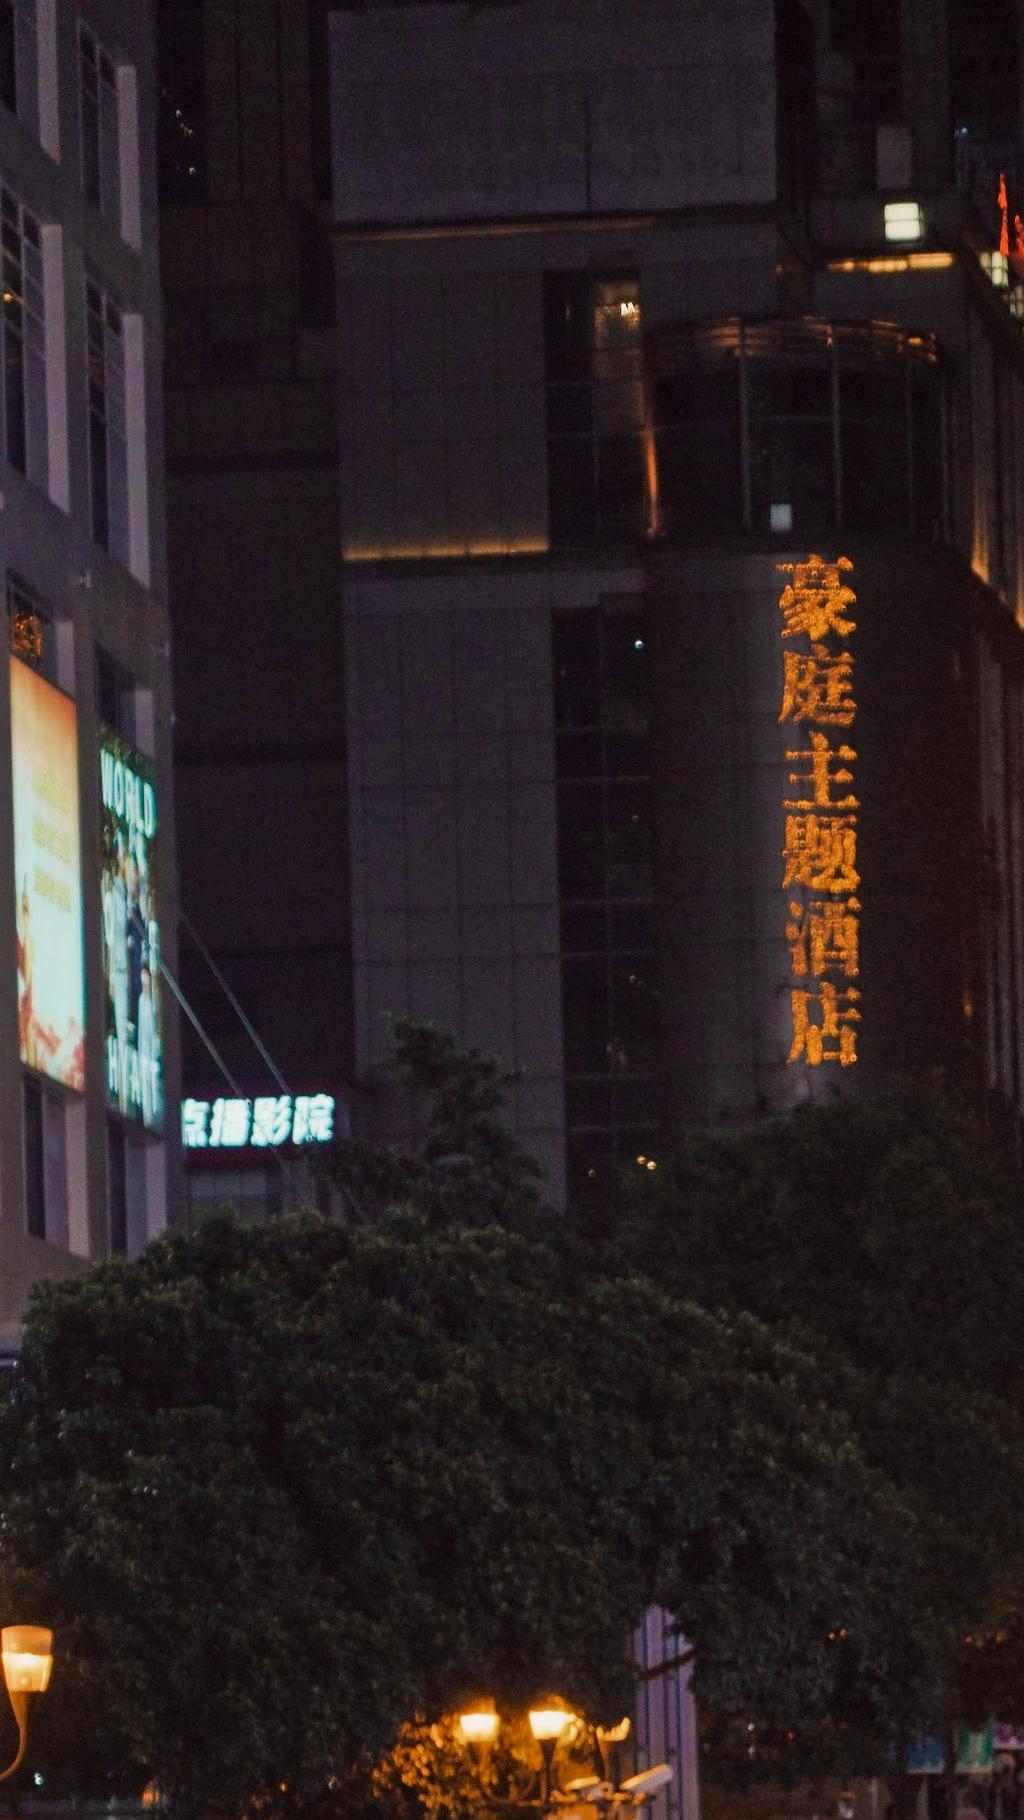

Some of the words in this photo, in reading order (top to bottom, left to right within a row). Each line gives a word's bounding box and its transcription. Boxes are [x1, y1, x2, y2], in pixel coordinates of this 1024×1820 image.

[101, 748, 157, 839] WORLD
[776, 554, 862, 1066] 豪庭主题酒店
[180, 1094, 335, 1148] 点播影院
